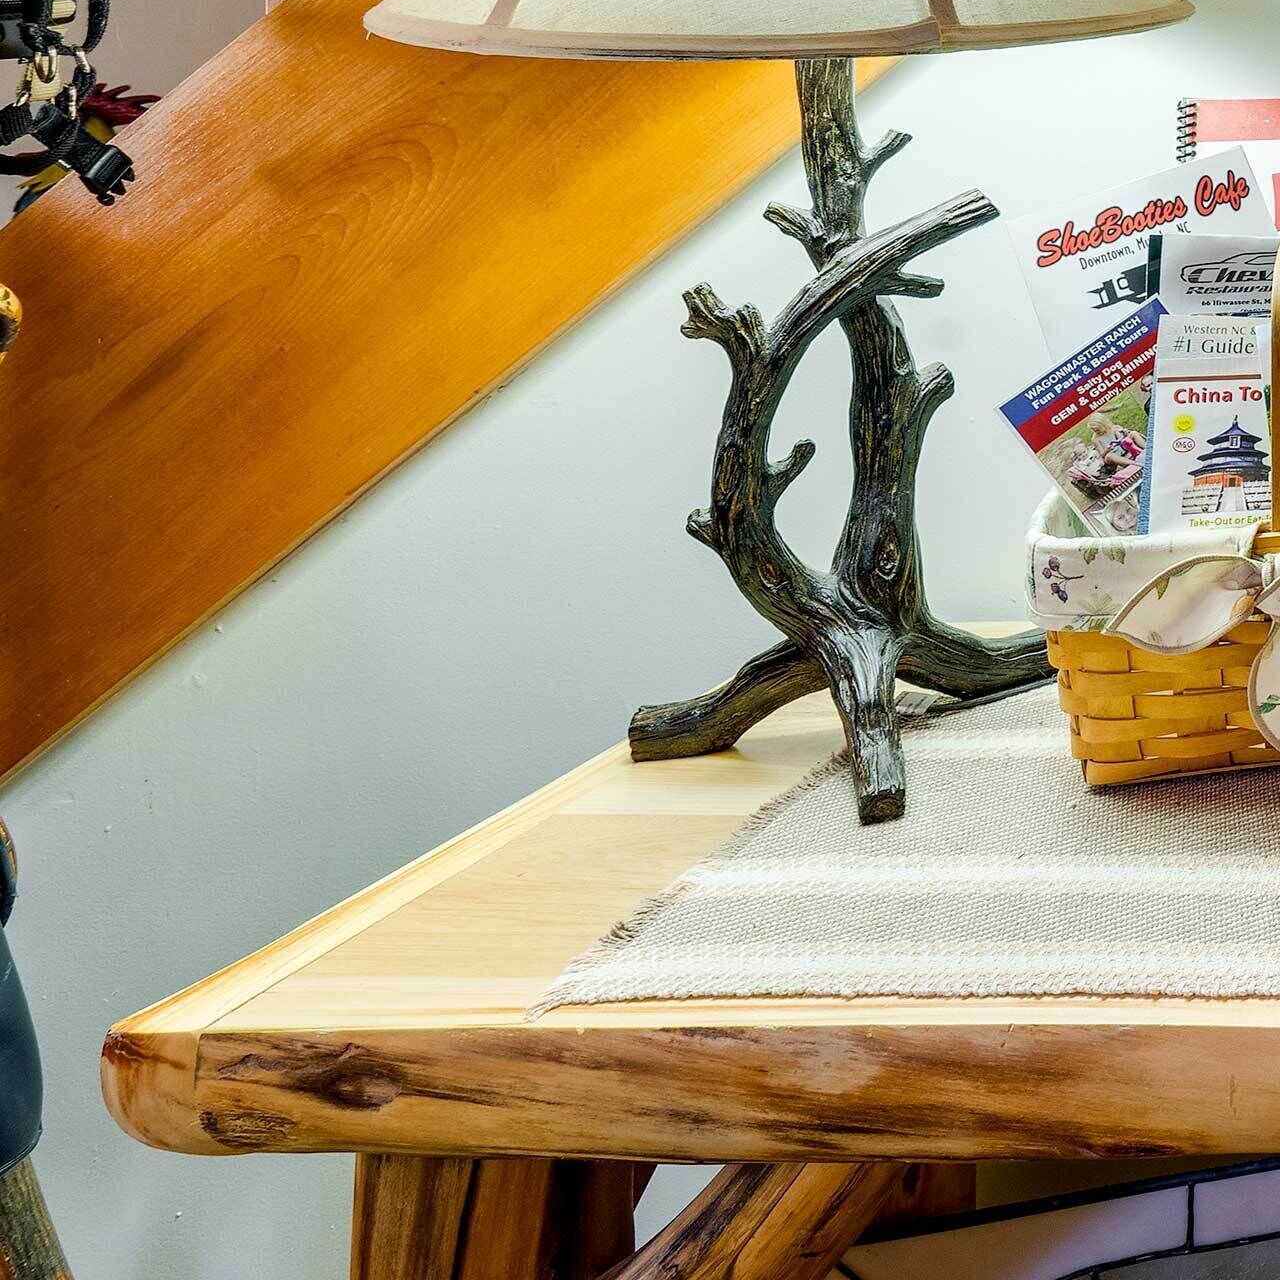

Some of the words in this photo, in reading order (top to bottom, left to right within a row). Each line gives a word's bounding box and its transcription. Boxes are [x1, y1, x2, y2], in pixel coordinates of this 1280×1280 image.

[1037, 196, 1188, 268] ShoeBooties
[1194, 170, 1250, 216] Cafe
[1079, 244, 1135, 270] Downtown,
[1176, 221, 1191, 233] NC
[1186, 284, 1272, 295] Restaura
[1173, 336, 1192, 353] #1
[1201, 337, 1255, 354] Guide
[1184, 325, 1228, 335] Western
[1231, 326, 1247, 335] NC
[1024, 341, 1106, 400] WAGONMASTER
[1104, 315, 1142, 345] RANCH
[1031, 391, 1056, 410] Fun
[1055, 373, 1082, 396] Park
[1081, 365, 1092, 375] &
[1090, 347, 1118, 368] Boat
[1116, 325, 1149, 349] Tours
[1076, 373, 1104, 395] Salty
[1101, 360, 1124, 377] Dog
[1089, 386, 1124, 411] Murphy,
[1121, 376, 1135, 390] NC
[1173, 387, 1233, 404] China
[1238, 386, 1263, 402] To
[1051, 403, 1078, 426] GEM
[1079, 396, 1089, 406] &
[1089, 373, 1121, 397] GOLD
[1189, 517, 1233, 528] Take-Out
